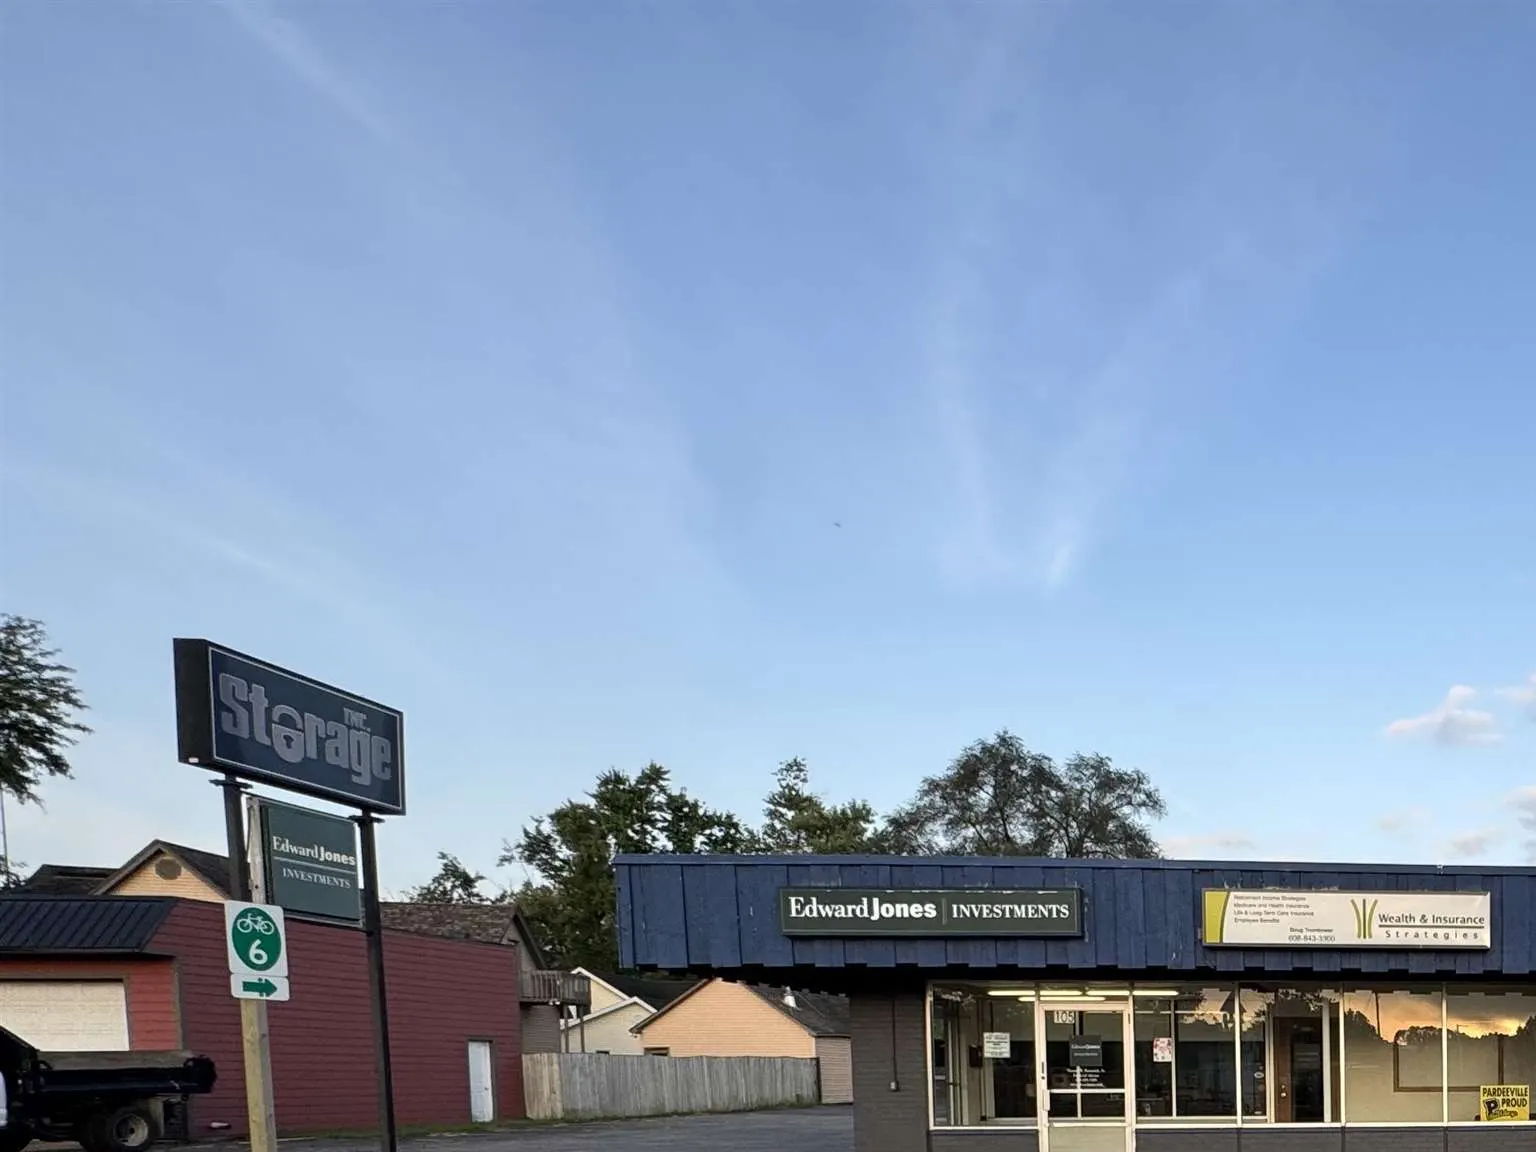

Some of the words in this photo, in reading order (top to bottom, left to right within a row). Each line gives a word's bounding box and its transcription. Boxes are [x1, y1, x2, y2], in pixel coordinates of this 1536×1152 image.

[218, 672, 393, 786] Storage
[282, 868, 351, 889] INVESTMENTS
[952, 903, 1070, 920] INVESTMENTS
[1378, 912, 1416, 924] Wealth
[1420, 913, 1428, 924] &
[1432, 914, 1485, 925] Insurance
[1385, 930, 1479, 940] Strategies
[249, 938, 269, 965] 6
[1053, 1010, 1075, 1023] 105
[1482, 1087, 1529, 1097] PARDEEVILLE
[1501, 1098, 1528, 1108] PROUD
